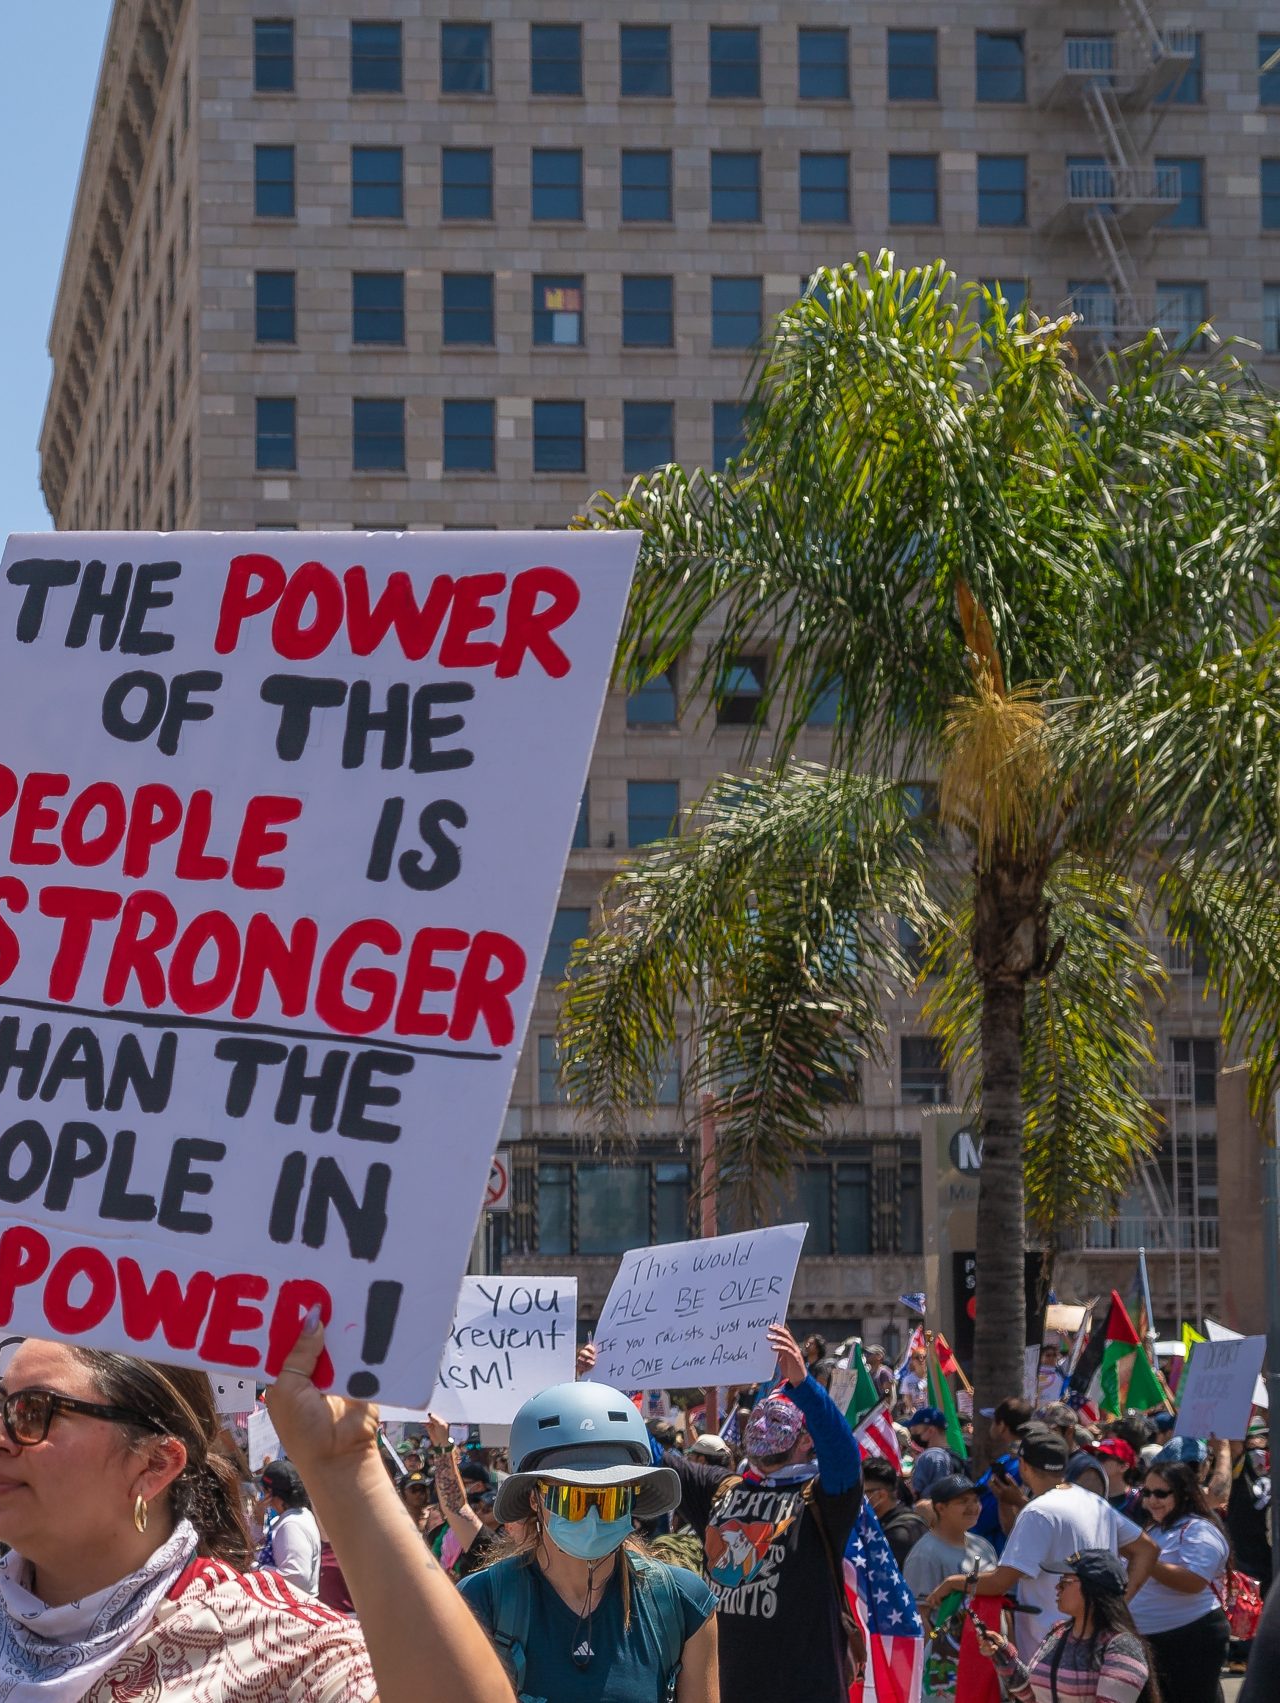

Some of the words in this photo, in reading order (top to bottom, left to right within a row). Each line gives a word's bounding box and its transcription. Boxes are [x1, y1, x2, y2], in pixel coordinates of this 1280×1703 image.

[7, 559, 182, 655] THE
[214, 553, 581, 680] POWER
[102, 670, 223, 756] OF
[260, 673, 476, 774] THE
[366, 796, 468, 891] IS
[214, 1038, 415, 1144] THE
[269, 1150, 391, 1262] IN
[629, 1254, 679, 1286] This
[693, 1241, 753, 1272] would
[476, 1284, 560, 1318] YOU
[609, 1289, 658, 1320] ALL
[674, 1287, 707, 1314] BE
[719, 1275, 783, 1302] OVER
[626, 1338, 645, 1354] you
[655, 1328, 704, 1346] racists
[710, 1318, 741, 1340] just
[608, 1363, 624, 1377] to
[631, 1358, 664, 1374] ONE
[768, 1544, 785, 1564] TO
